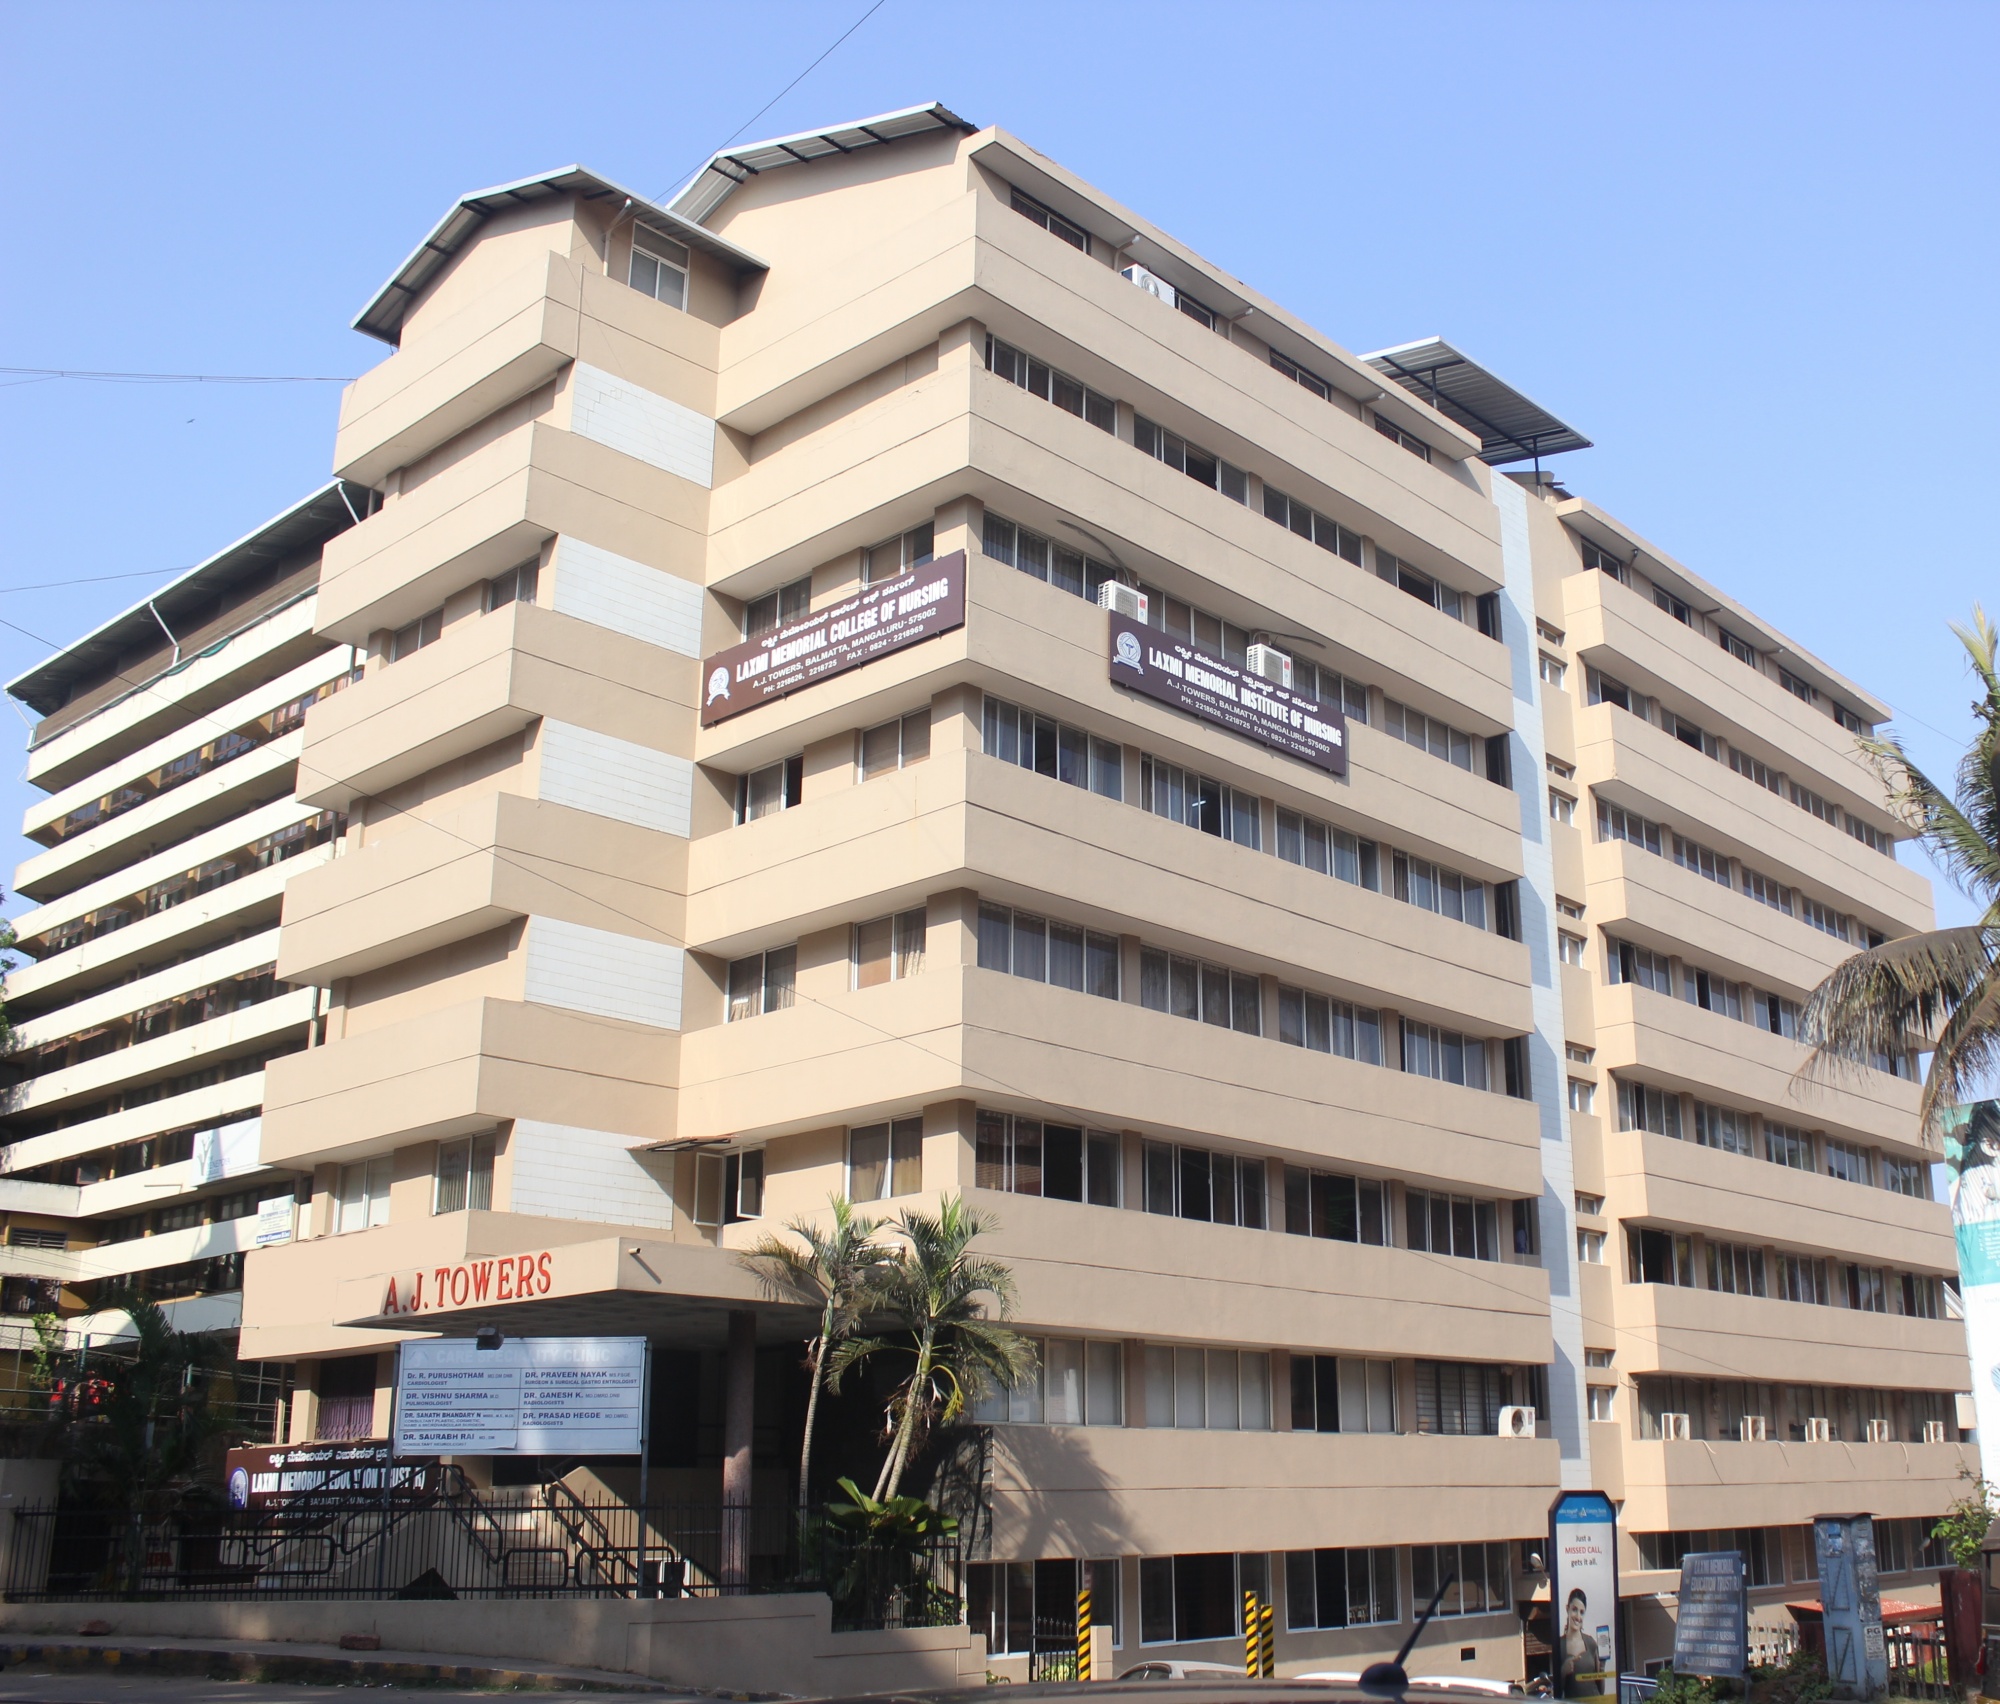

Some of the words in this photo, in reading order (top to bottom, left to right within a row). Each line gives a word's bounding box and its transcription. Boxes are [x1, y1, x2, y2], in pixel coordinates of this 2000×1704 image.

[736, 652, 769, 682] LAXMI
[771, 628, 828, 668] MEMORIAL
[830, 607, 878, 643] COLLEGE
[880, 599, 896, 622] OF
[898, 577, 948, 616] NURSING
[752, 677, 767, 688] A.J.
[768, 662, 803, 681] TOWERS,
[805, 645, 850, 666] BALMATTA,
[763, 684, 775, 694] PH:
[809, 659, 837, 676] 2218725
[869, 639, 887, 652] 0824
[893, 624, 924, 642] 2218969
[1149, 647, 1183, 678] LAXMI
[1185, 662, 1239, 702] MEMORIAL
[1240, 687, 1289, 724] INSTITUTE
[1290, 709, 1303, 729] OF
[1303, 715, 1342, 747] NURSING
[1167, 678, 1181, 691] A.J.
[1182, 684, 1218, 706] TOWERS,
[1219, 700, 1260, 725] BALMATTA,
[1181, 695, 1193, 706] PH:
[1195, 701, 1223, 719] 2218626,
[1225, 713, 1251, 730] 2218725
[1254, 725, 1270, 738] FAX:
[1270, 733, 1286, 744] 0824
[1290, 741, 1316, 757] 2218969
[383, 1272, 428, 1315] A.J.
[434, 1251, 552, 1307] TOWERS
[436, 1349, 473, 1363] CARE
[563, 1348, 610, 1362] CLINIC
[252, 1472, 279, 1493] LAXMI
[280, 1470, 327, 1492] MEMORIAL
[1571, 1559, 1583, 1568] gets
